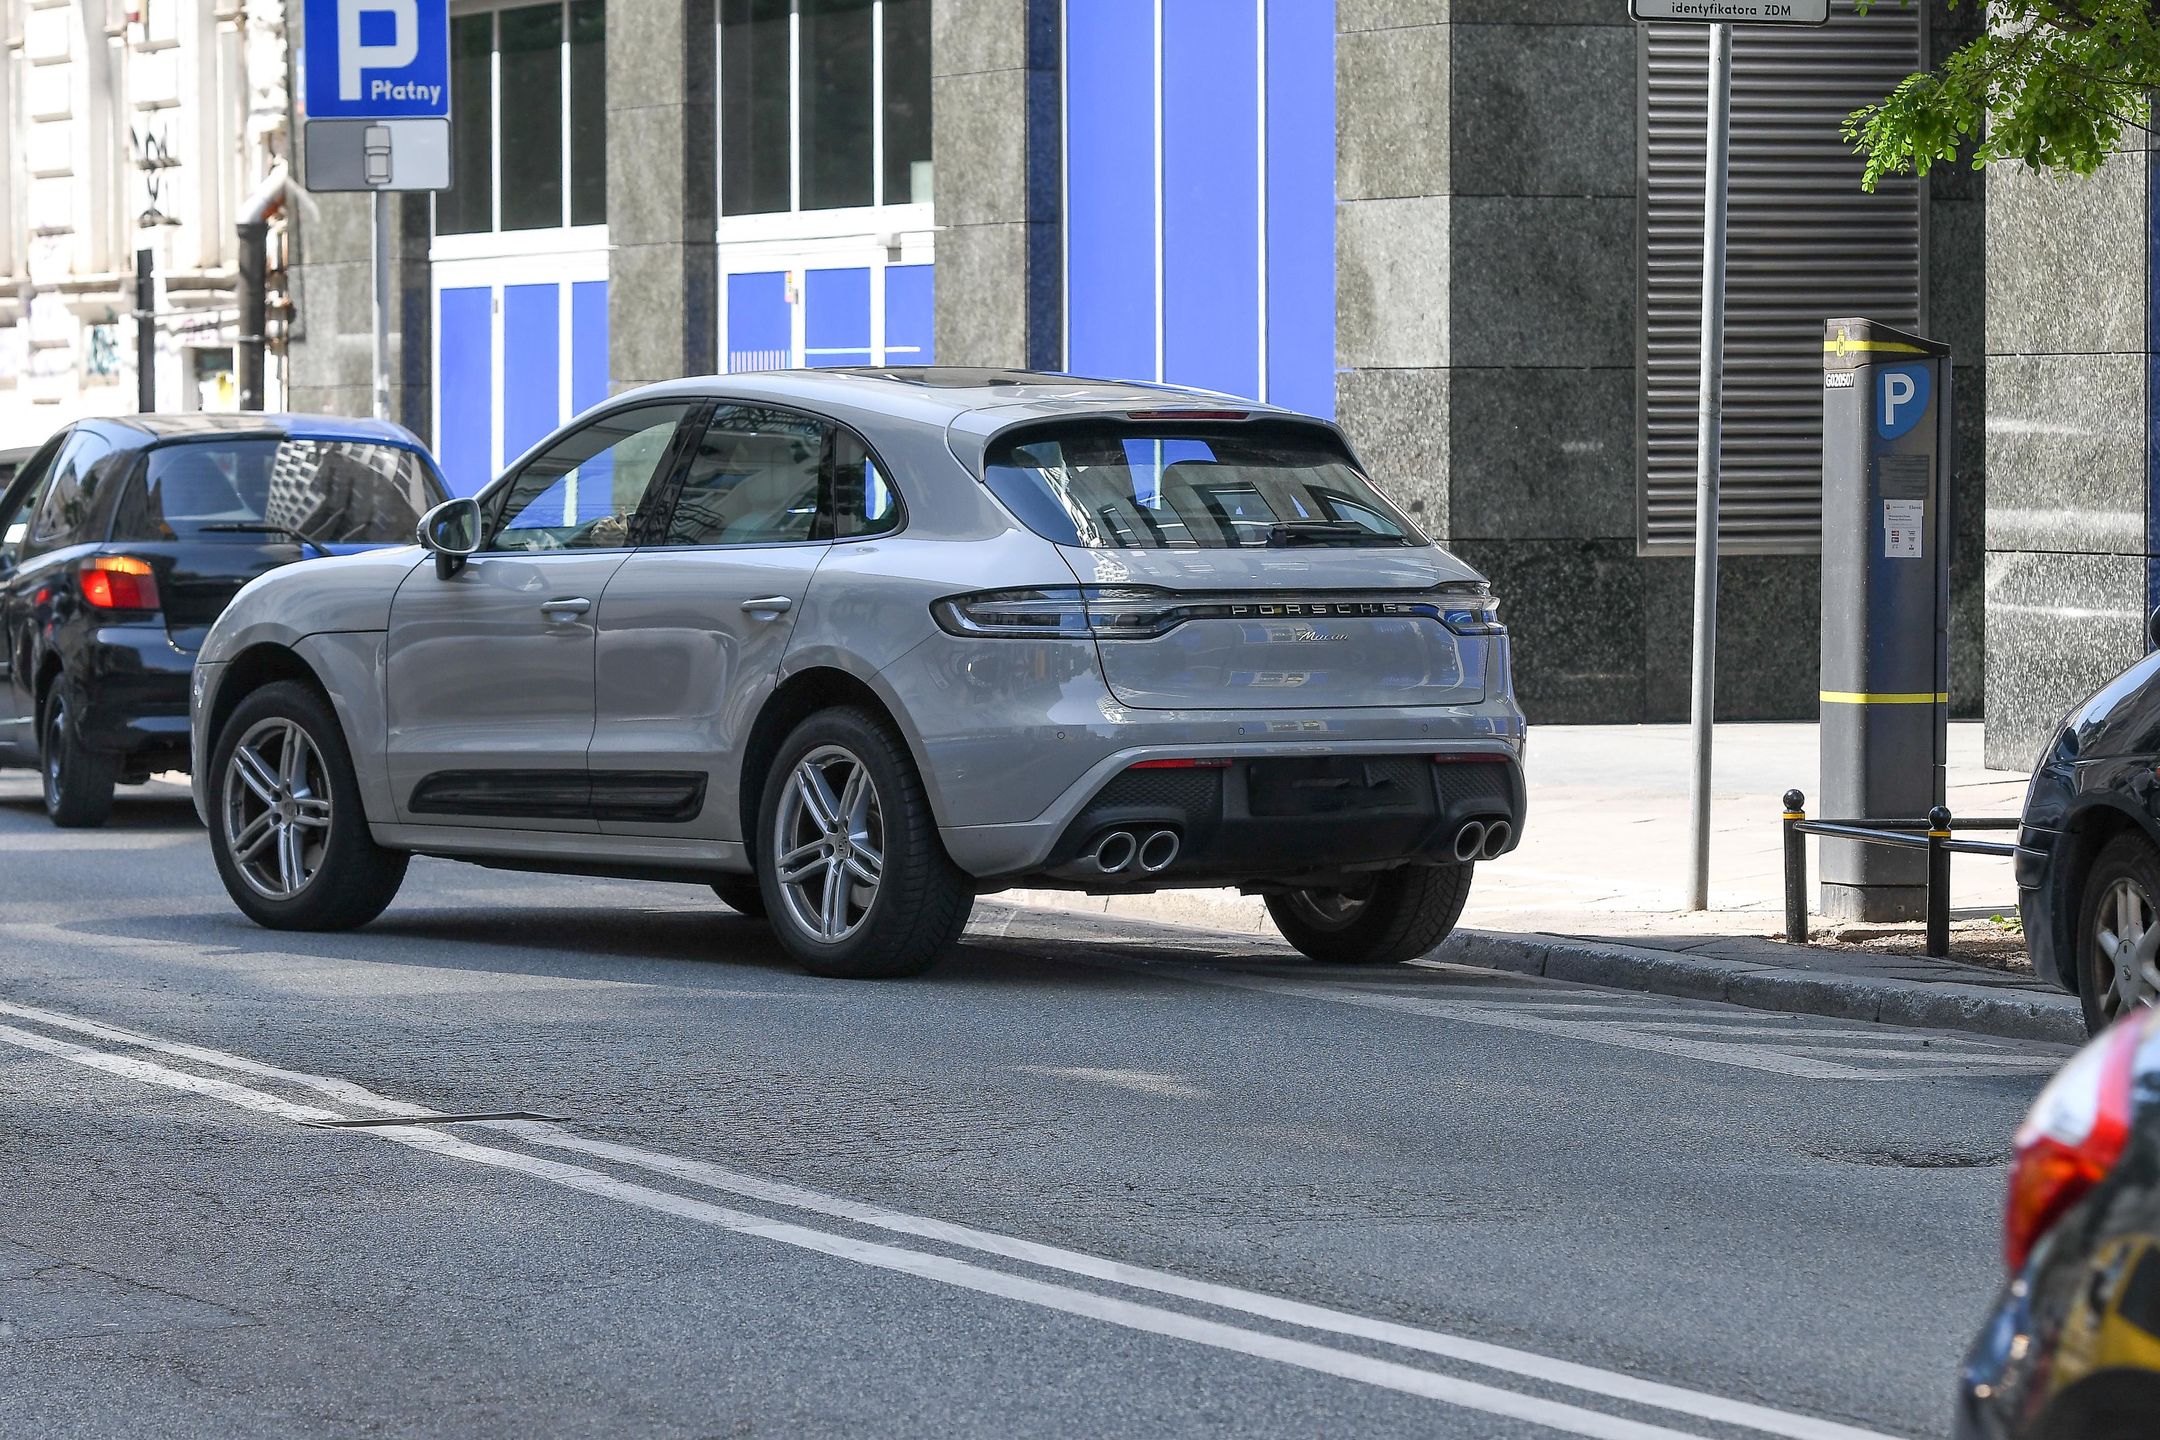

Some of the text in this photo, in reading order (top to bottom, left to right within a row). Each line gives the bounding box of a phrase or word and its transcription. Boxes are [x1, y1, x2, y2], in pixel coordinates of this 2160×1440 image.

[1671, 2, 1791, 16] identyfikatora ZDM
[337, 0, 419, 101] P
[371, 79, 441, 106] Płatny
[1884, 373, 1915, 425] P
[1231, 603, 1397, 615] PORSCHE
[1299, 631, 1349, 641] Macan
